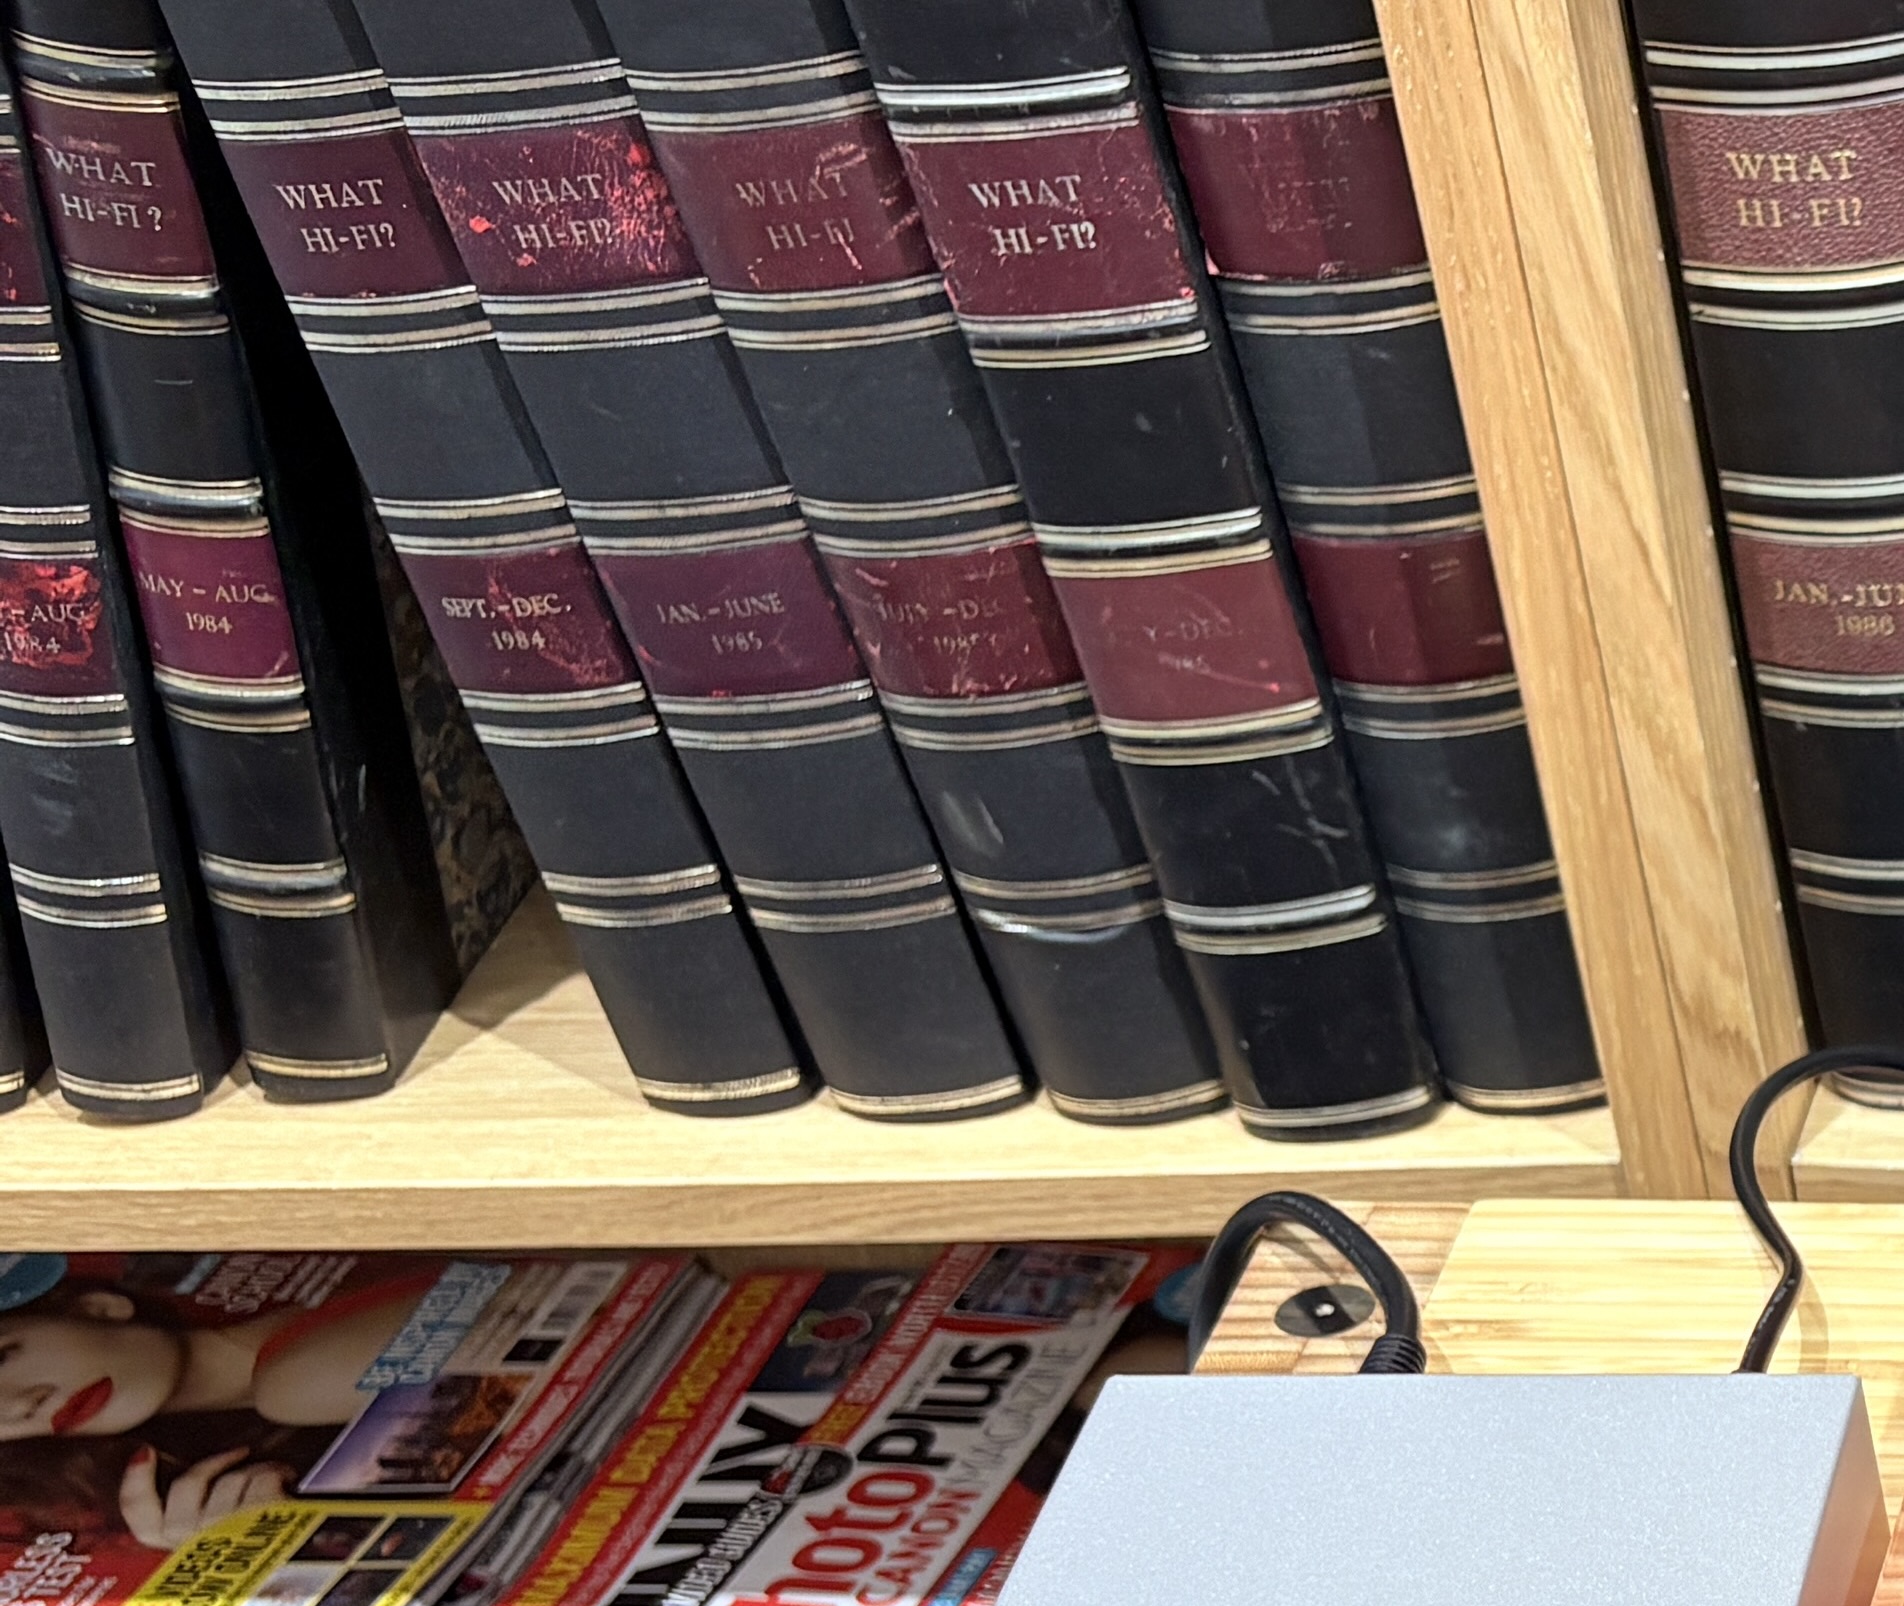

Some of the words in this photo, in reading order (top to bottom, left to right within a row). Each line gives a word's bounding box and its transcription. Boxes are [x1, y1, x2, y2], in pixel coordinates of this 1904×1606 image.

[44, 147, 156, 187] WHAT
[1726, 150, 1856, 182] WHAT
[276, 178, 384, 210] WHAT
[491, 173, 603, 206] WHAT
[734, 171, 852, 209] WHAT
[968, 173, 1081, 210] WHAT
[1737, 198, 1863, 229] HI-FI?
[300, 221, 396, 253] HI-FI?
[185, 612, 233, 634] 1984
[492, 630, 545, 650] 1984
